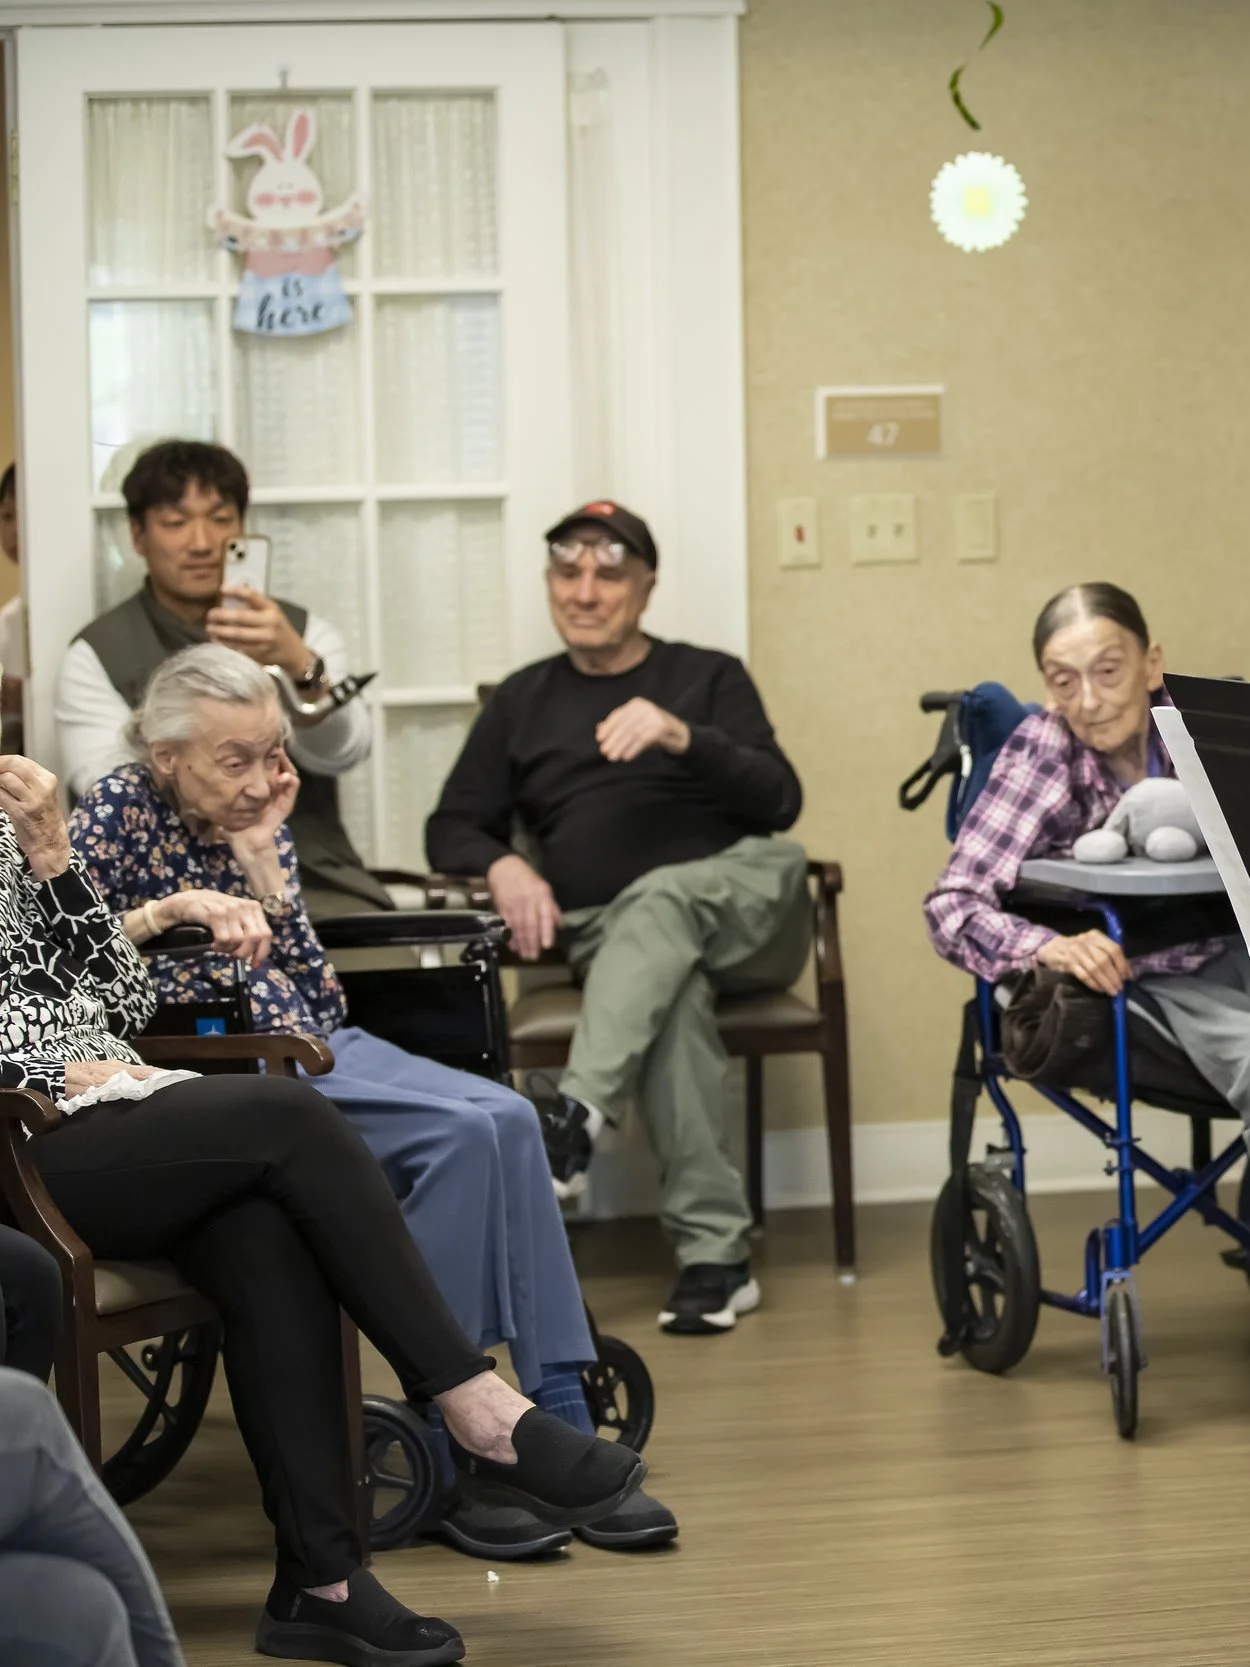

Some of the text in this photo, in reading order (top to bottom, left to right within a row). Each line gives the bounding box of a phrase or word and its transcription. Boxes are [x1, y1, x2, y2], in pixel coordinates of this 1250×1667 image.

[282, 277, 304, 297] is
[257, 293, 323, 330] here
[866, 421, 901, 446] 47
